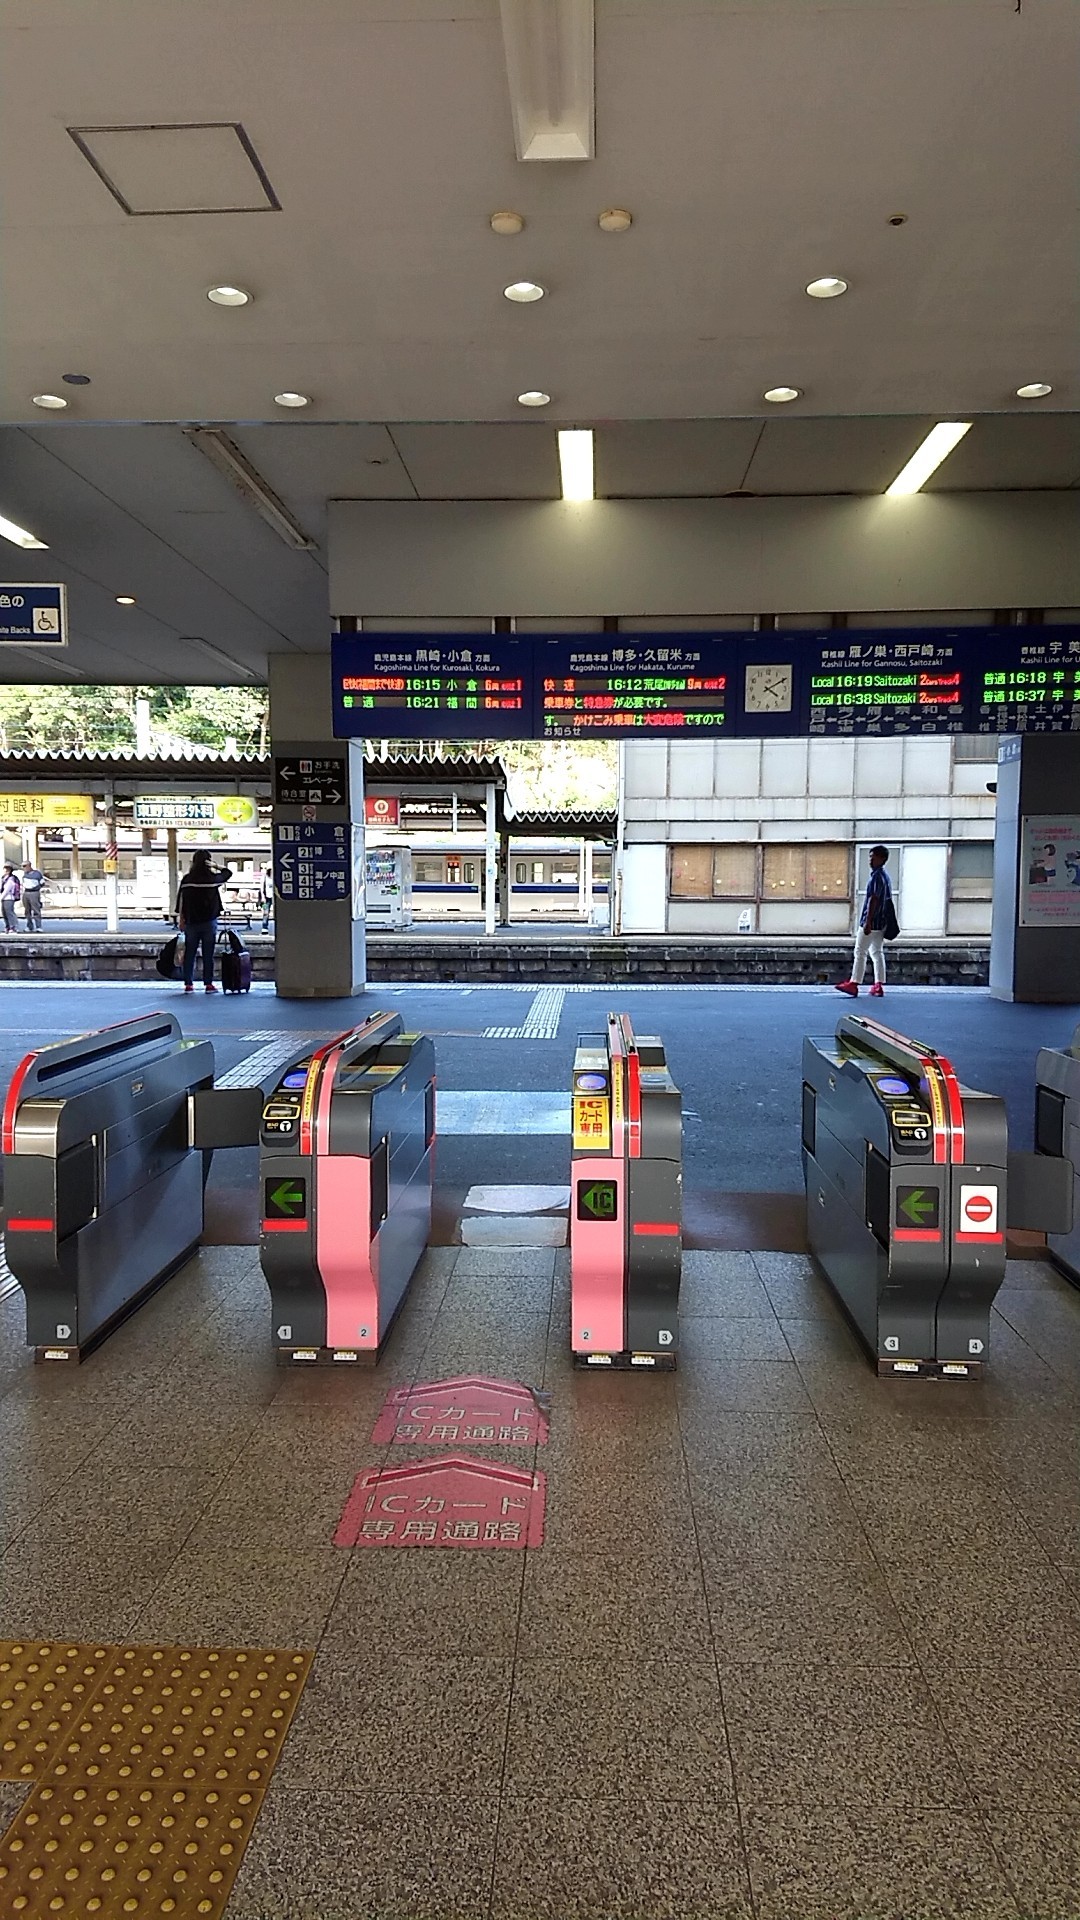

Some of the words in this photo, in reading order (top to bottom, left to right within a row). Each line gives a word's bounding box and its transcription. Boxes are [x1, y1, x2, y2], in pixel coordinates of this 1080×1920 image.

[374, 654, 412, 662] 鹿児島本線
[416, 649, 472, 662] 黒崎・小倉
[475, 654, 490, 662] 方面
[570, 654, 609, 662] 鹿児島本線
[612, 648, 682, 662] 博多・久留米
[684, 653, 700, 661] 方面
[848, 644, 934, 658] 雁ノ巣・西戸崎
[937, 648, 953, 656] 方面
[844, 660, 860, 668] Line
[874, 660, 908, 668] Gannosu,
[1020, 656, 1043, 664] Kashii
[1044, 656, 1060, 664] Line
[374, 664, 412, 672] Kagoshima
[414, 664, 429, 672] Line
[430, 664, 441, 672] for
[442, 664, 474, 672] Kurosaki,
[476, 664, 500, 672] Kokura
[570, 664, 608, 673] Kagoshima
[610, 664, 624, 672] Line
[638, 664, 665, 672] Hakata,
[406, 679, 441, 690] 16:15
[606, 678, 642, 690] 16:12
[812, 676, 834, 688] Local
[836, 676, 873, 688] 16:19
[874, 674, 917, 686] Saitozaki
[984, 672, 1006, 685] 普通
[1009, 672, 1046, 684] 16:18
[406, 696, 440, 708] 16:21
[811, 693, 833, 706] Local
[836, 692, 872, 706] 16:38
[873, 692, 916, 704] Saitozaki
[984, 690, 1005, 703] 普通
[1008, 690, 1046, 702] 16:37
[544, 727, 582, 736] お知らせ
[580, 1100, 602, 1108] IC
[580, 1110, 603, 1122] カード
[580, 1123, 603, 1133] 専用
[593, 1192, 611, 1208] IC
[60, 1328, 64, 1336] 1
[283, 1328, 288, 1336] 1
[361, 1328, 367, 1336] 2
[584, 1332, 589, 1340] 2
[890, 1340, 896, 1348] 3
[972, 1342, 978, 1350] 4
[397, 1406, 535, 1421] ICカード
[396, 1425, 531, 1442] 専用通路
[364, 1494, 527, 1515] ICカード
[359, 1520, 522, 1542] 専用通路
